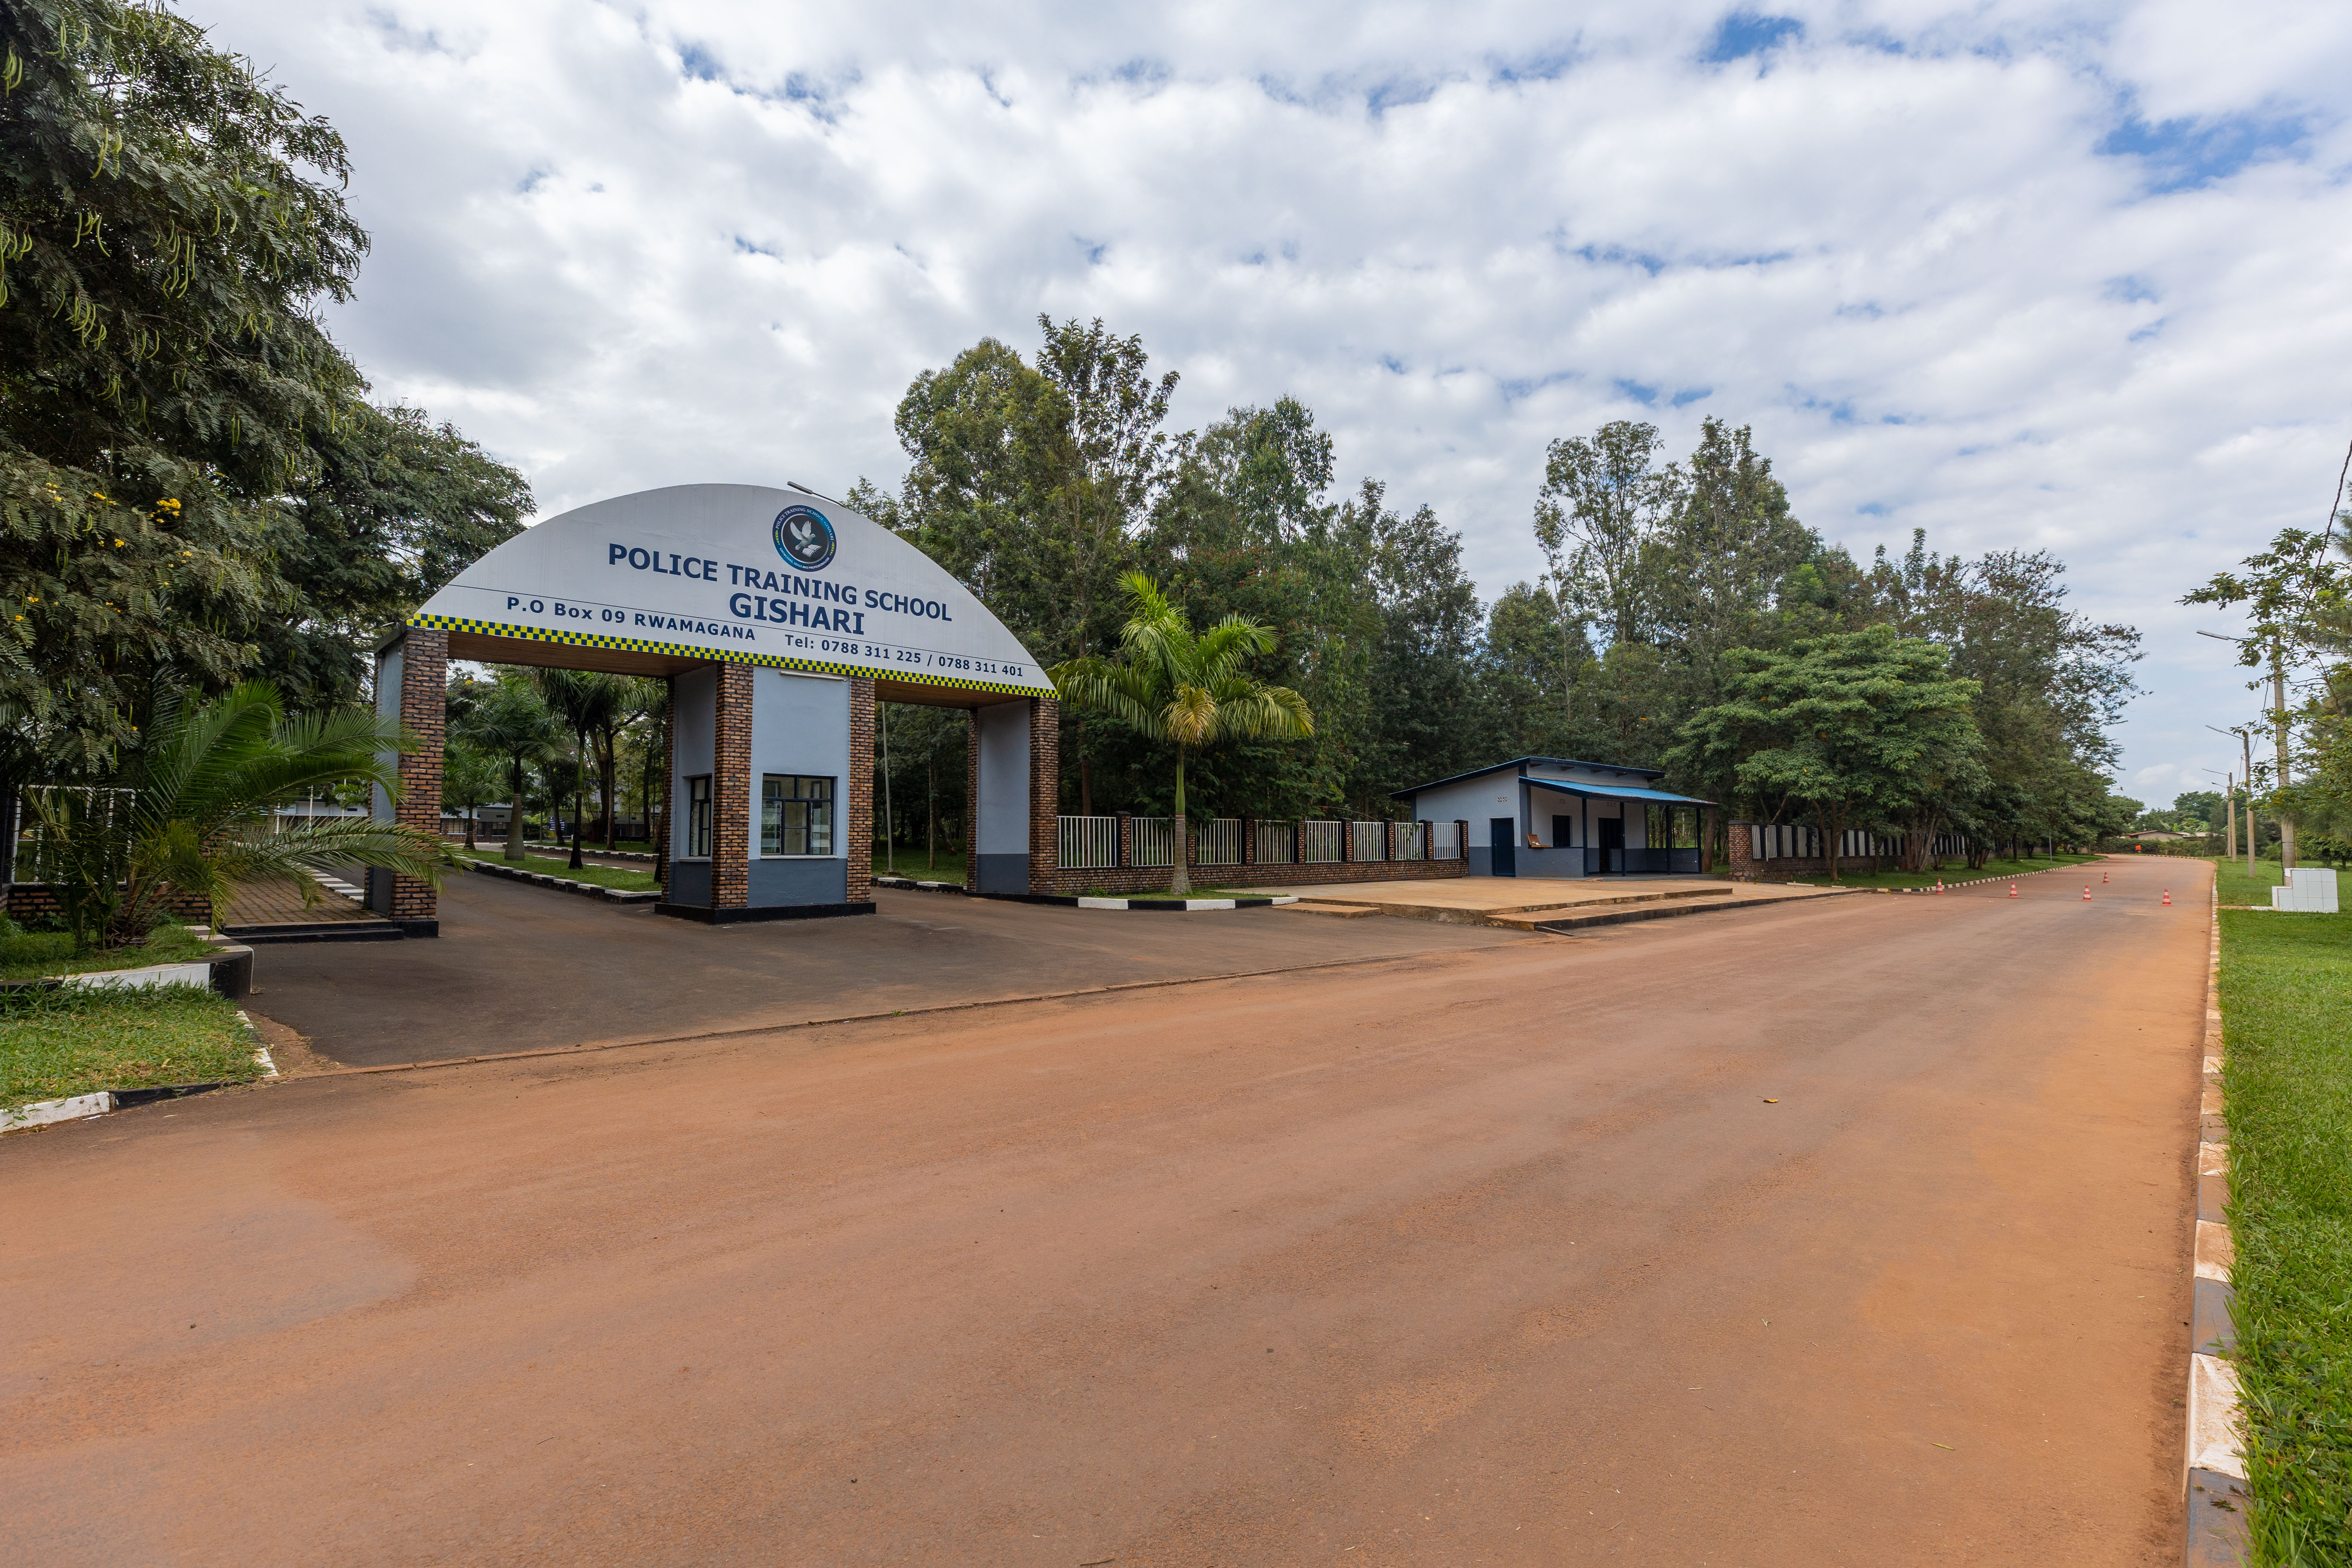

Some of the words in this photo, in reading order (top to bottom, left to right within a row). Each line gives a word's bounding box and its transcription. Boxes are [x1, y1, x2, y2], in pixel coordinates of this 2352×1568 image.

[775, 514, 786, 529] POLICE
[784, 507, 806, 515] TRAINING
[609, 543, 718, 582] POLICE
[726, 564, 857, 605] TRAINING
[865, 590, 952, 622] SCHOOL
[507, 597, 545, 613] P.O
[554, 602, 593, 620] Box
[602, 609, 625, 624] 09
[634, 613, 755, 641] RWAMAGANA
[729, 593, 865, 636] GISHARI
[784, 634, 815, 649] Tel:
[821, 640, 859, 655] 0788
[865, 646, 890, 659] 311
[897, 650, 921, 663] 225
[927, 654, 933, 667] /
[939, 656, 970, 671] 0788
[975, 661, 997, 674] 311
[1002, 665, 1023, 677] 401
